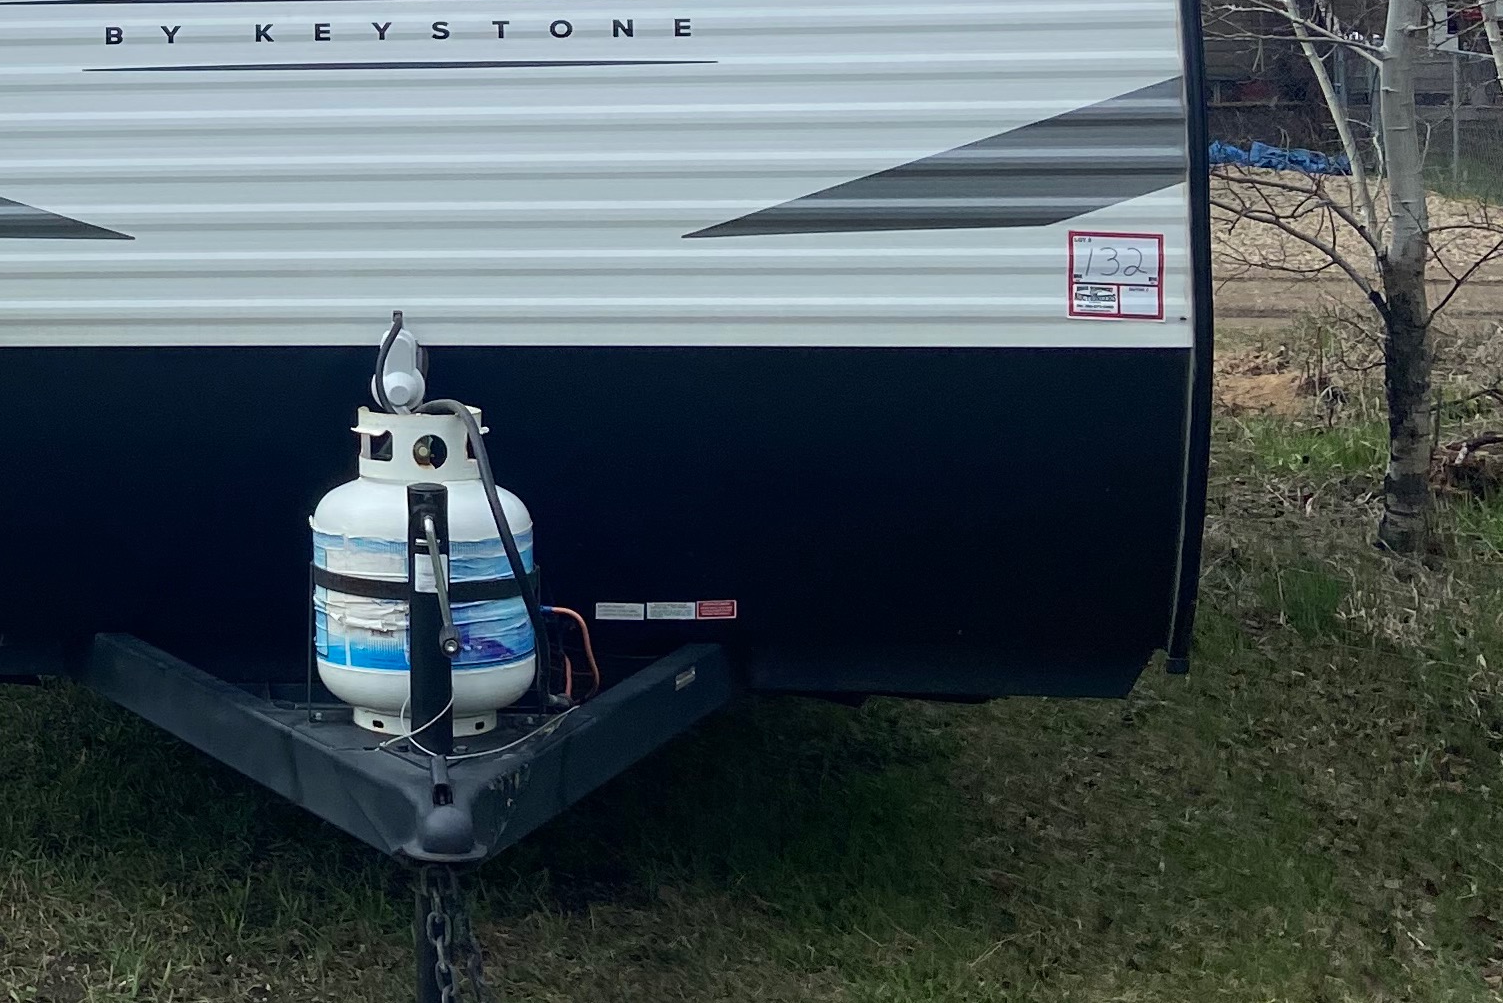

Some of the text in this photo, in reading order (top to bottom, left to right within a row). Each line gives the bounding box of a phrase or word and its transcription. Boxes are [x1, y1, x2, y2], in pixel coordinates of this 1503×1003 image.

[105, 18, 692, 44] BY KEYSTONE
[1085, 247, 1148, 277] 132
